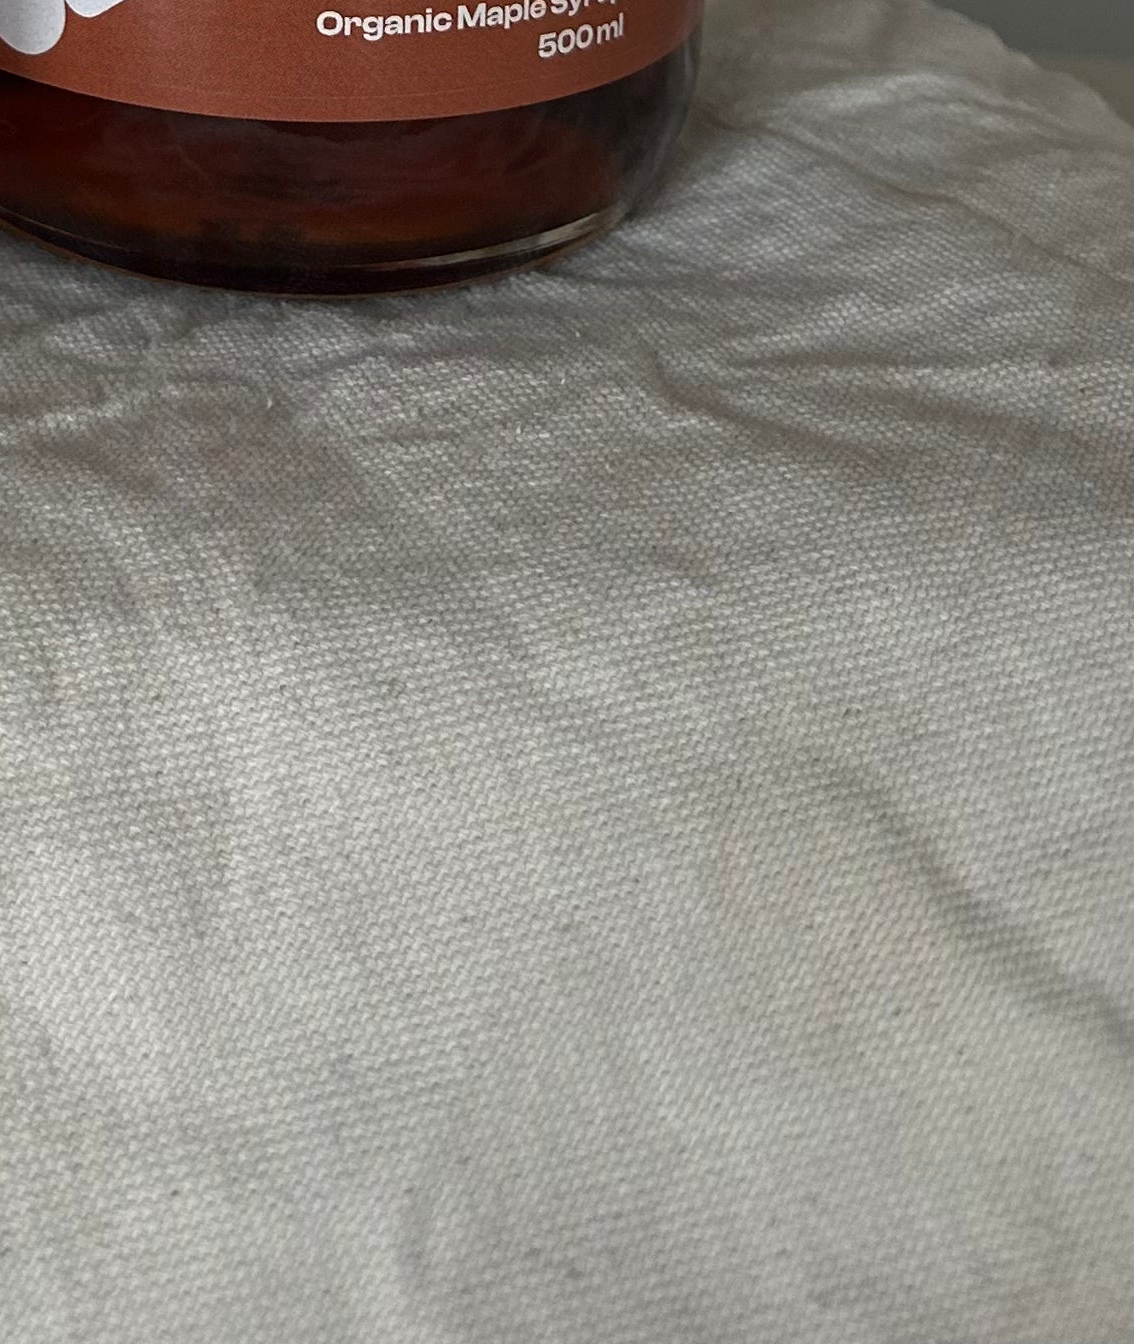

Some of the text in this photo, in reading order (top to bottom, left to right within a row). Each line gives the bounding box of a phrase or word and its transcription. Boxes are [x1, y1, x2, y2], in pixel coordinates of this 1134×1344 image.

[316, 7, 453, 42] Organic
[537, 12, 624, 60] 500 ml
